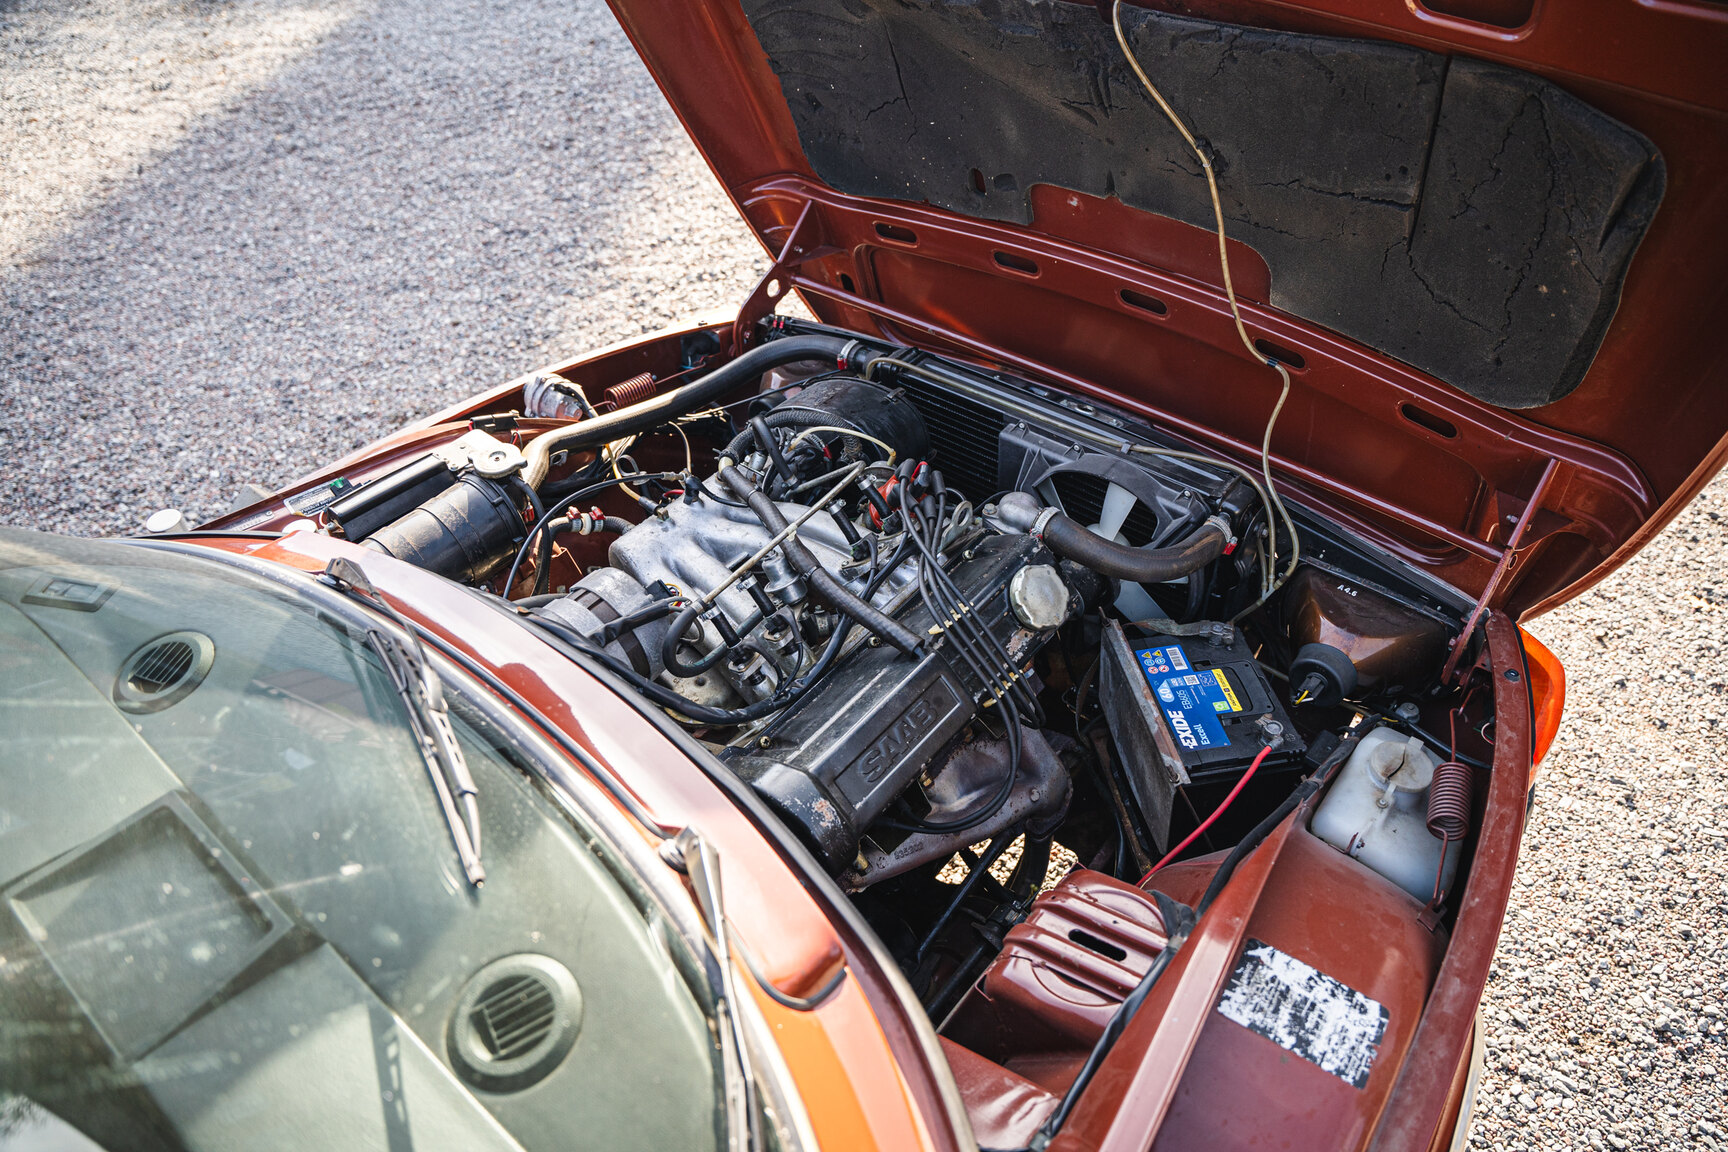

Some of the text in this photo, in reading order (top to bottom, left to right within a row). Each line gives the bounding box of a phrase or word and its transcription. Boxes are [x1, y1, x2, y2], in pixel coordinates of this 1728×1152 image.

[1159, 688, 1173, 699] 60
[1176, 689, 1193, 710] EB605
[1167, 709, 1199, 748] EXIDE
[1193, 723, 1211, 745] Excell
[857, 700, 938, 783] SAAB
